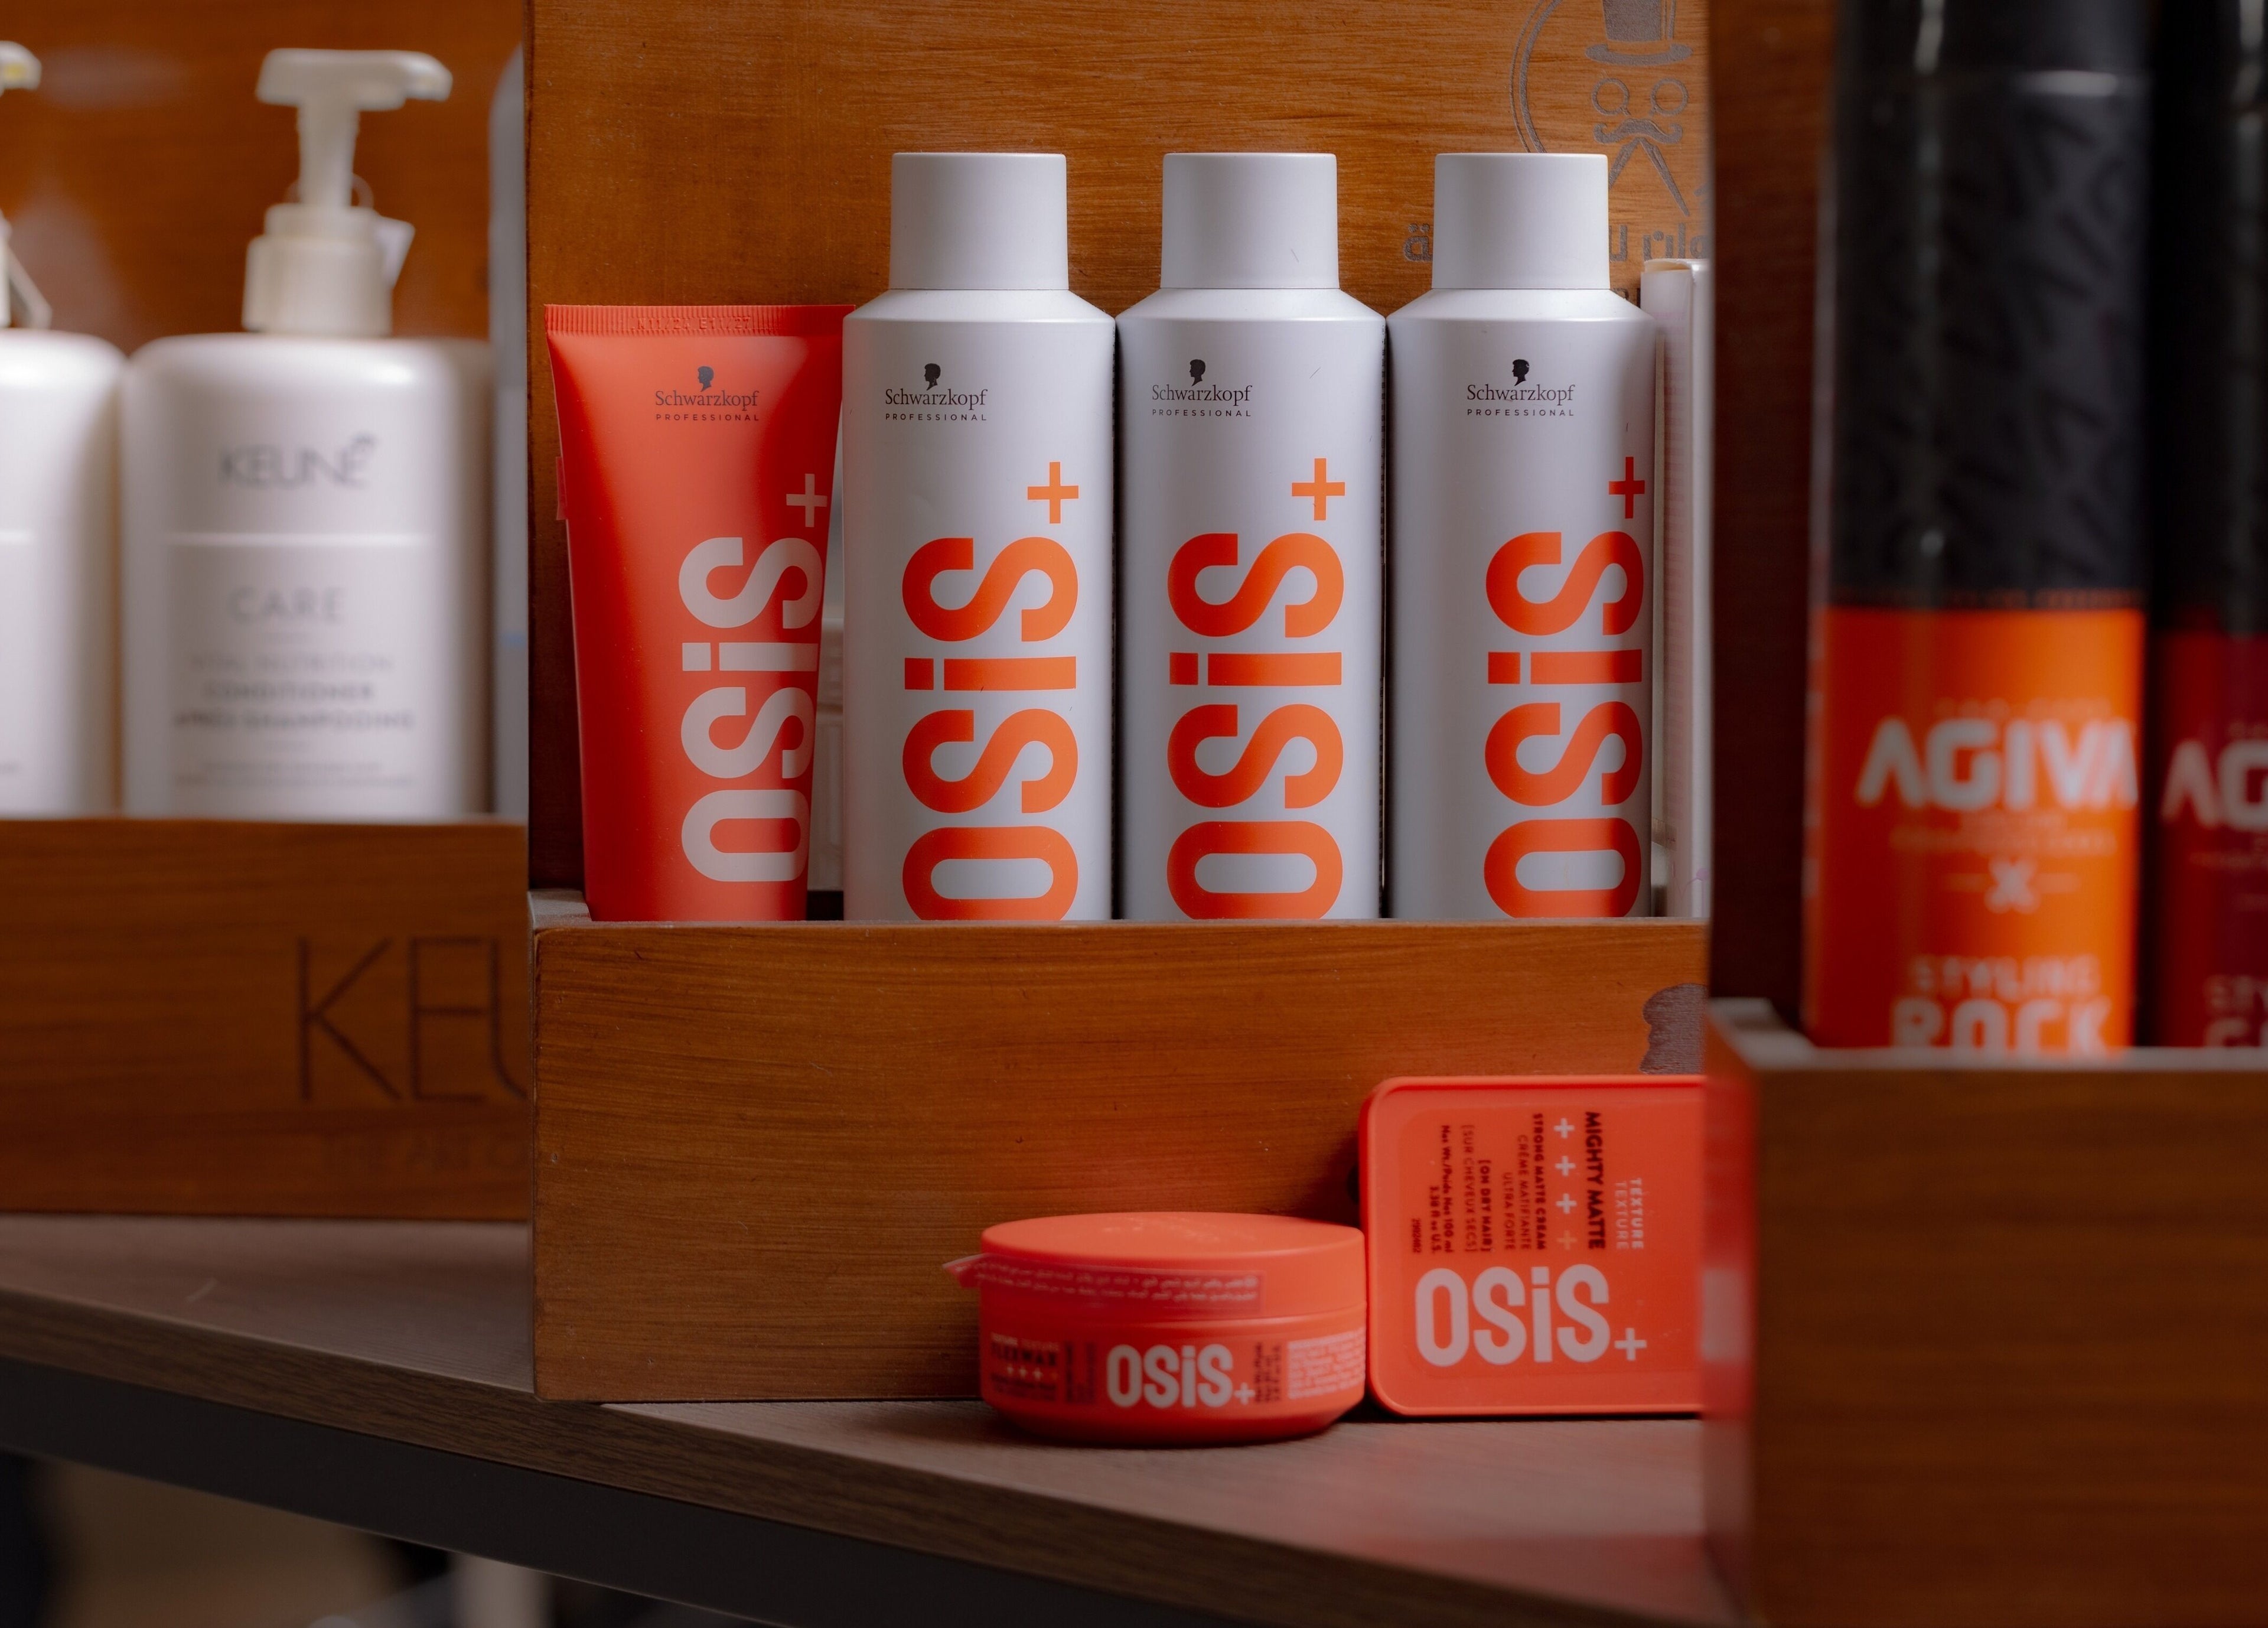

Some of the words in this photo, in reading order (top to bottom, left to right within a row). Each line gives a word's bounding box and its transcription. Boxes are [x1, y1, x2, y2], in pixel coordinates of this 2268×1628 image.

[655, 390, 760, 411] Schwarzkopf
[885, 388, 988, 408] Schwarzkopf
[1152, 384, 1252, 404] Schwarzkopf
[1152, 409, 1252, 417] PROFESSIONAL
[1467, 384, 1575, 406] Schwarzkopf
[885, 413, 987, 422] PROFESSIONAL
[229, 588, 346, 625] CARE
[1855, 716, 2139, 810] AGIVA
[1533, 1113, 1544, 1162] STRONG
[1585, 1111, 1604, 1186] MIGHTY
[1464, 1157, 1477, 1215] CHEVEUX
[1480, 1188, 1491, 1212] DRY
[1502, 1172, 1515, 1209] ULTRA
[1534, 1165, 1546, 1204] MATTE
[1445, 1218, 1454, 1238] 100
[1504, 1212, 1516, 1251] FORTE
[1536, 1207, 1547, 1251] CREAM
[1587, 1189, 1605, 1250] MATTE
[1615, 1180, 1630, 1250] TEXTURE
[1630, 1177, 1644, 1250] TEXTURE
